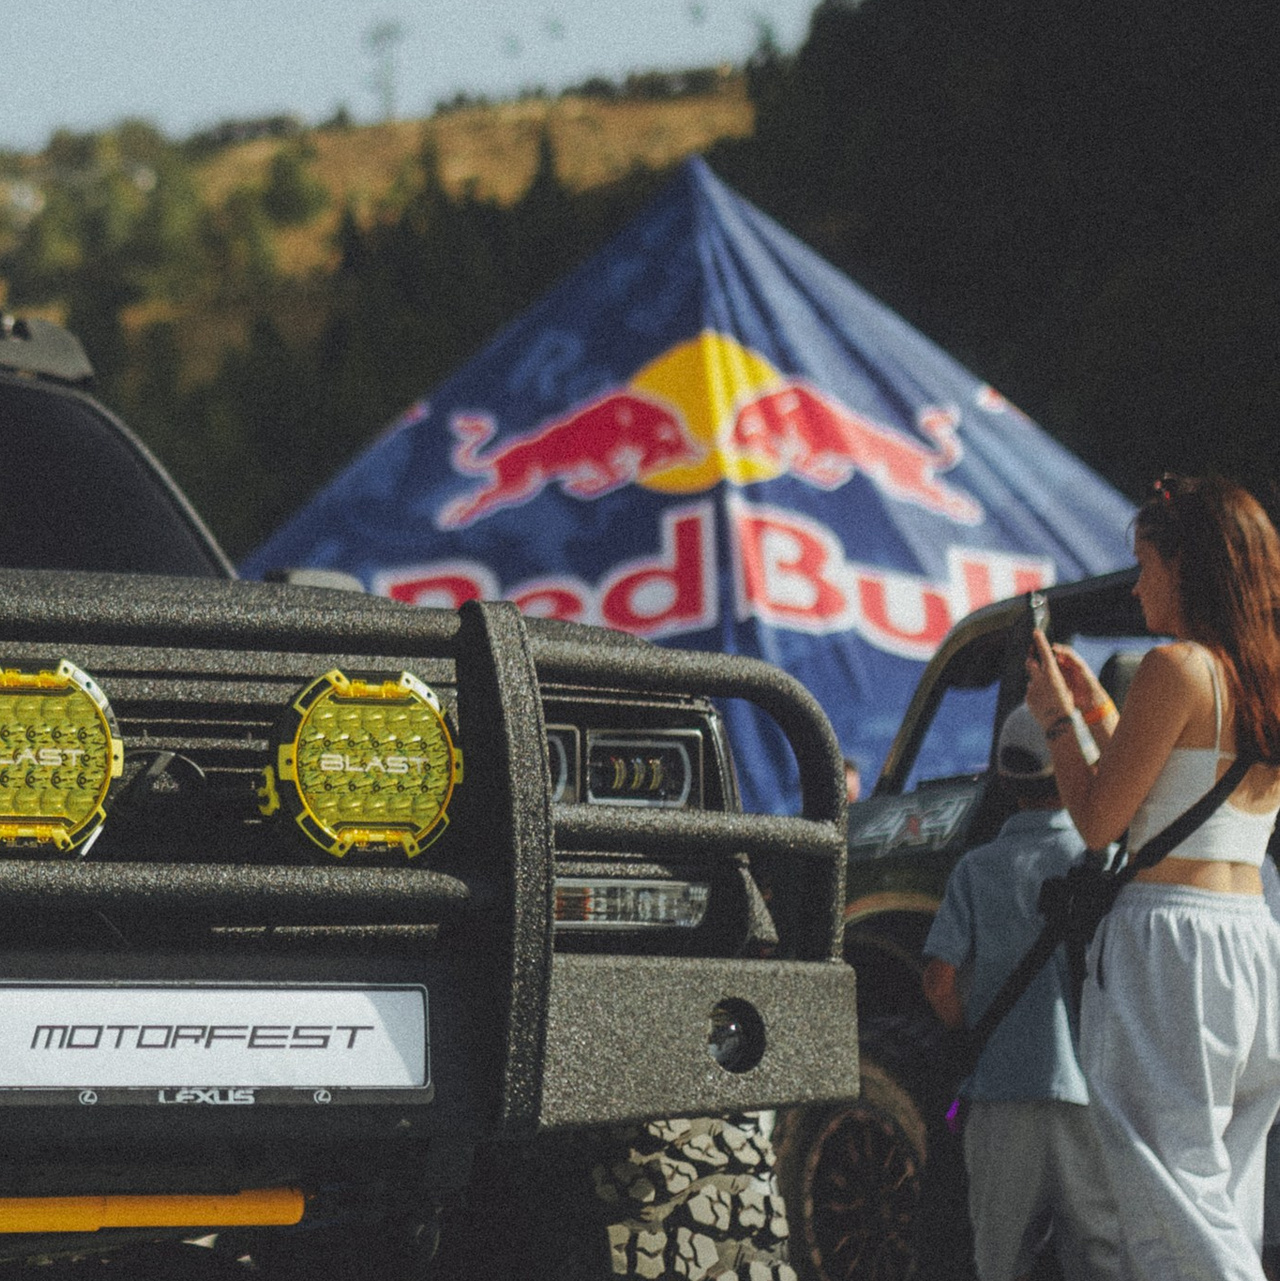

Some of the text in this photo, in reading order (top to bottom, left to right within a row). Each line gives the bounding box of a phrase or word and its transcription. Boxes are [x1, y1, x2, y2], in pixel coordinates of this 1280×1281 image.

[736, 511, 1048, 652] Bu
[320, 753, 429, 774] BLAST
[29, 1024, 375, 1050] MOTORFEST
[158, 1089, 255, 1105] LEXUS
